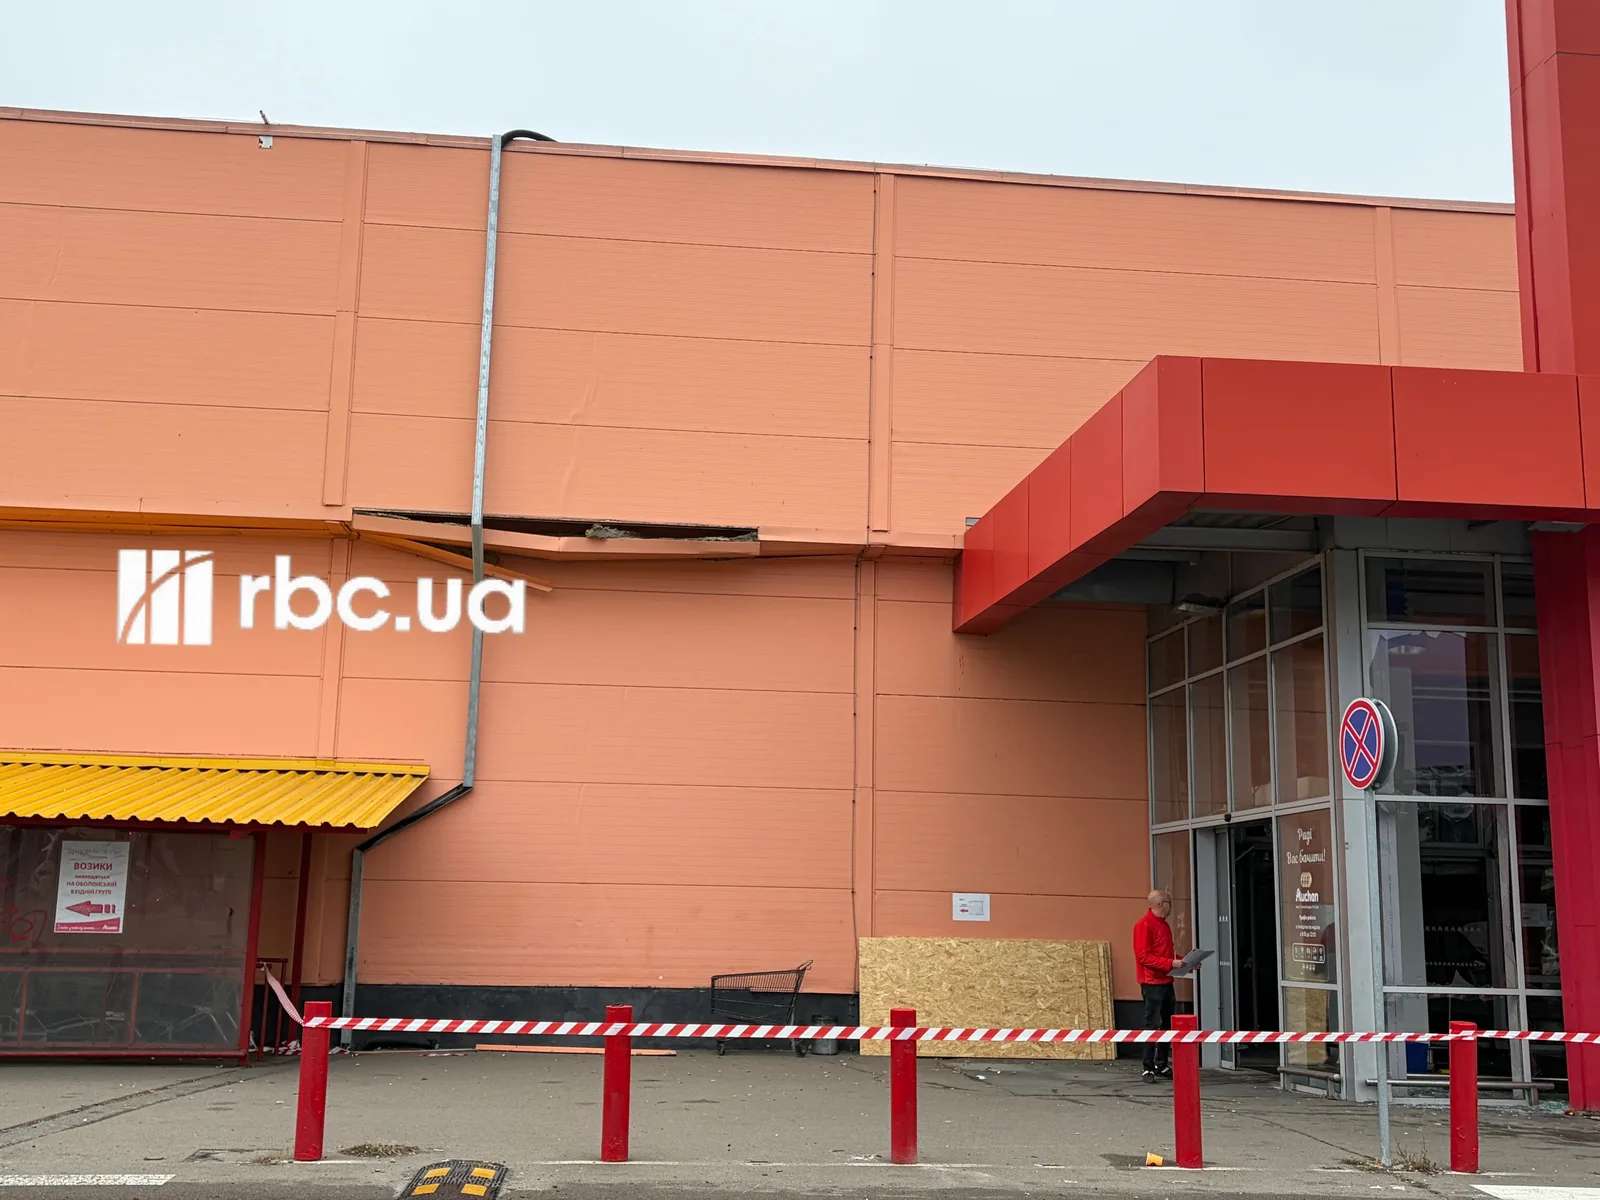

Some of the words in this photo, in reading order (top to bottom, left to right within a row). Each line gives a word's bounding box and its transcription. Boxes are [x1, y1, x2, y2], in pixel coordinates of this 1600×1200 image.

[1285, 851, 1299, 865] Вас
[73, 862, 113, 871] ВОЗИКИ
[1295, 887, 1319, 903] Auchan
